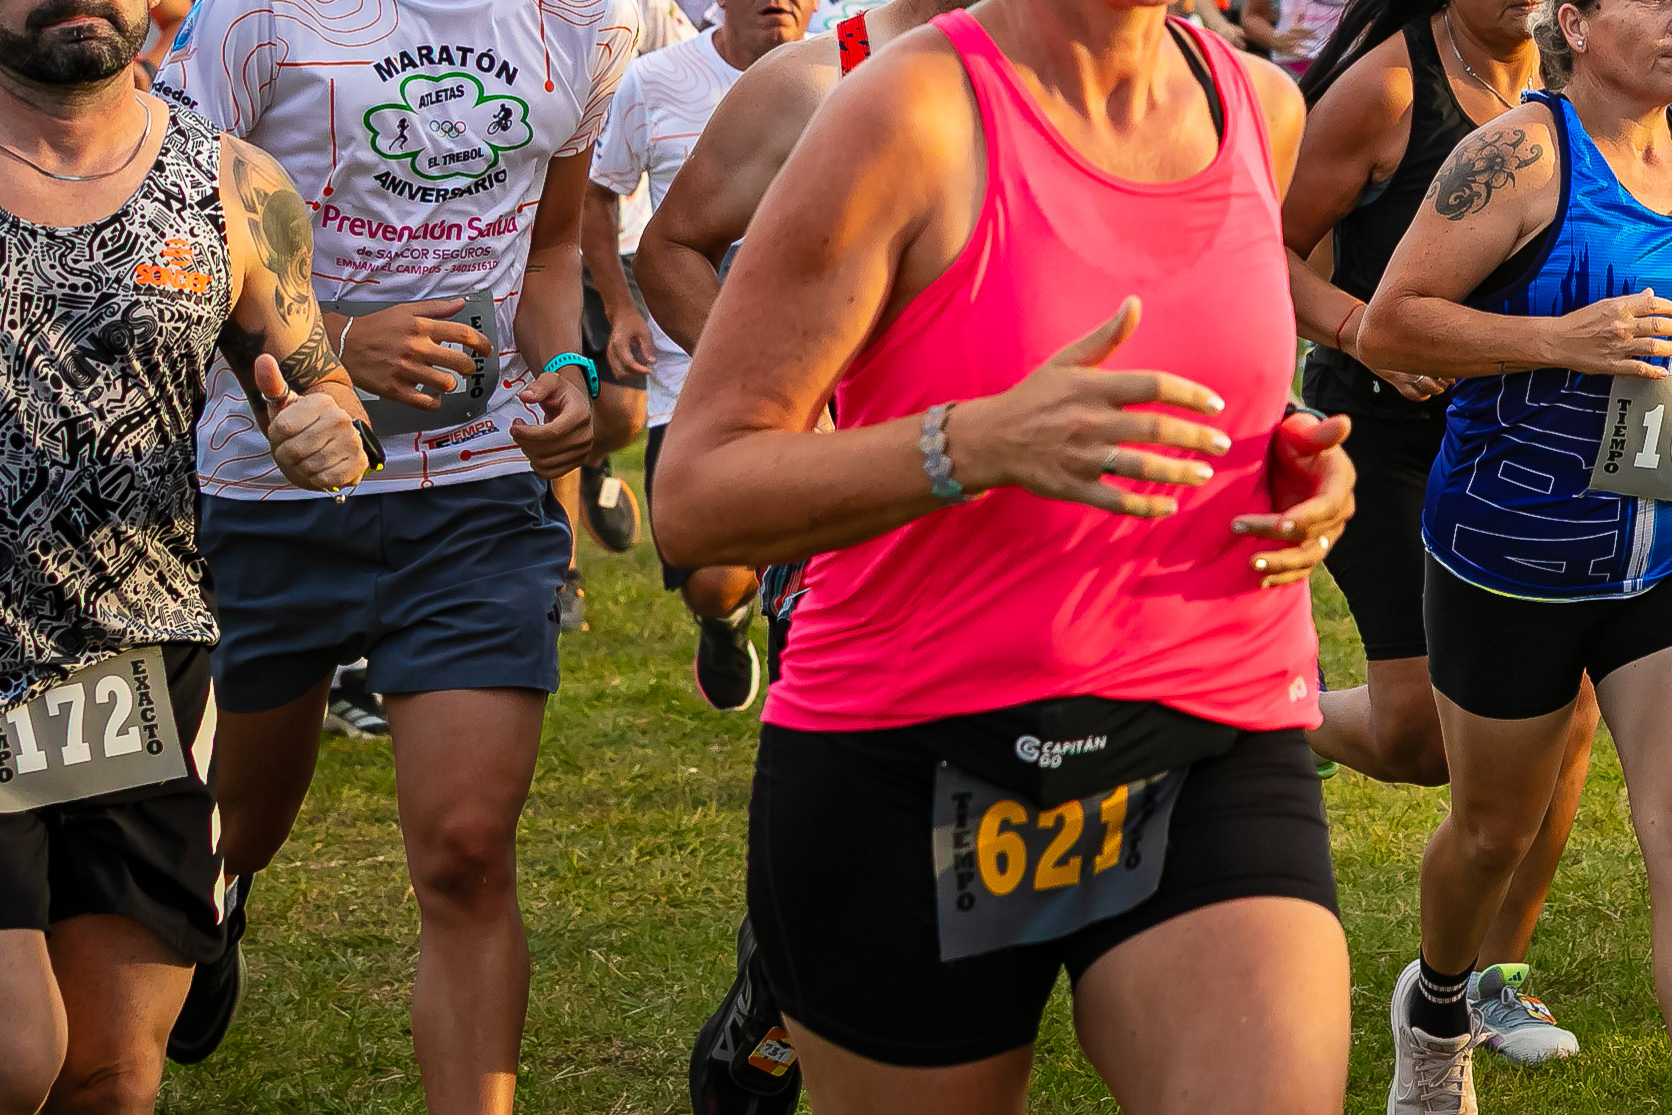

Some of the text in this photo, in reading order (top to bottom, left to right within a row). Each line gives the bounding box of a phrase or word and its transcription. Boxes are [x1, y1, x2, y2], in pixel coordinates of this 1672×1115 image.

[373, 45, 519, 86] MARATÓN
[418, 84, 465, 109] ATLETAS
[427, 147, 485, 169] EL TREBOL
[373, 169, 508, 203] ANIVERSARIO
[356, 246, 373, 257] de
[433, 246, 491, 260] SEGUROS
[396, 264, 441, 275] CAMPOS
[1603, 398, 1633, 474] TIEMPO
[6, 675, 143, 775] 172
[130, 659, 164, 756] EXACTO
[1041, 735, 1108, 755] CAPITÁN
[952, 791, 976, 912] TIEMPO
[976, 784, 1129, 897] 621
